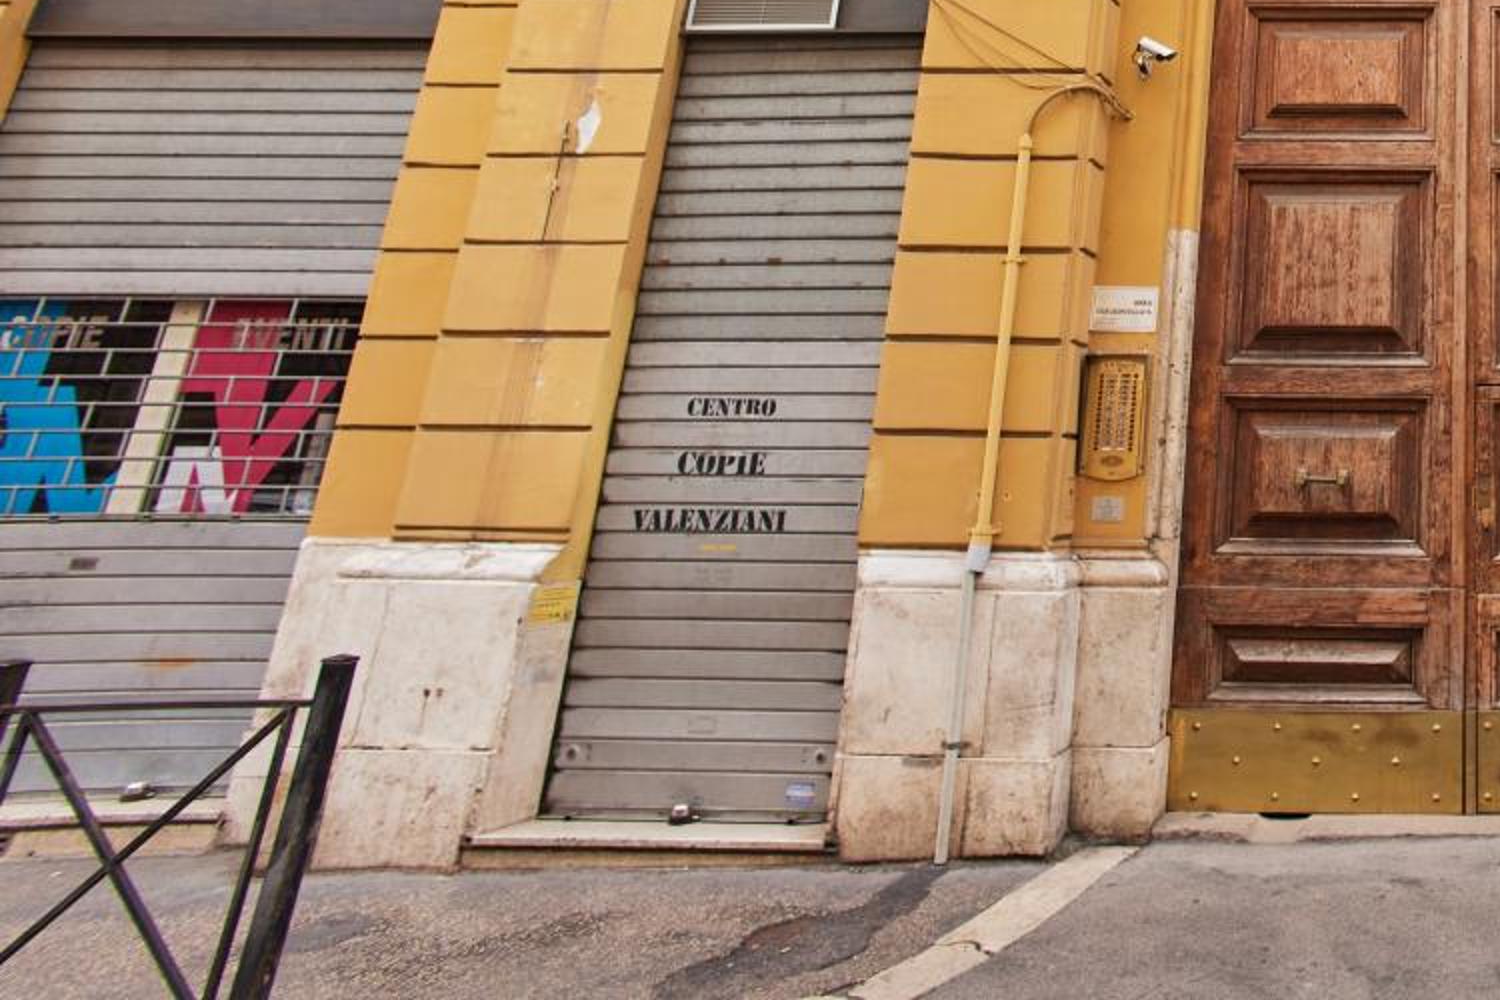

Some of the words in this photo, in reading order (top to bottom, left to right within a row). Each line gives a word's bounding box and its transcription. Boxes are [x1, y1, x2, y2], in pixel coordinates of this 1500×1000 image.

[687, 397, 777, 417] CENTRO
[677, 450, 768, 476] COPIE
[633, 508, 787, 533] VALENZIANI
